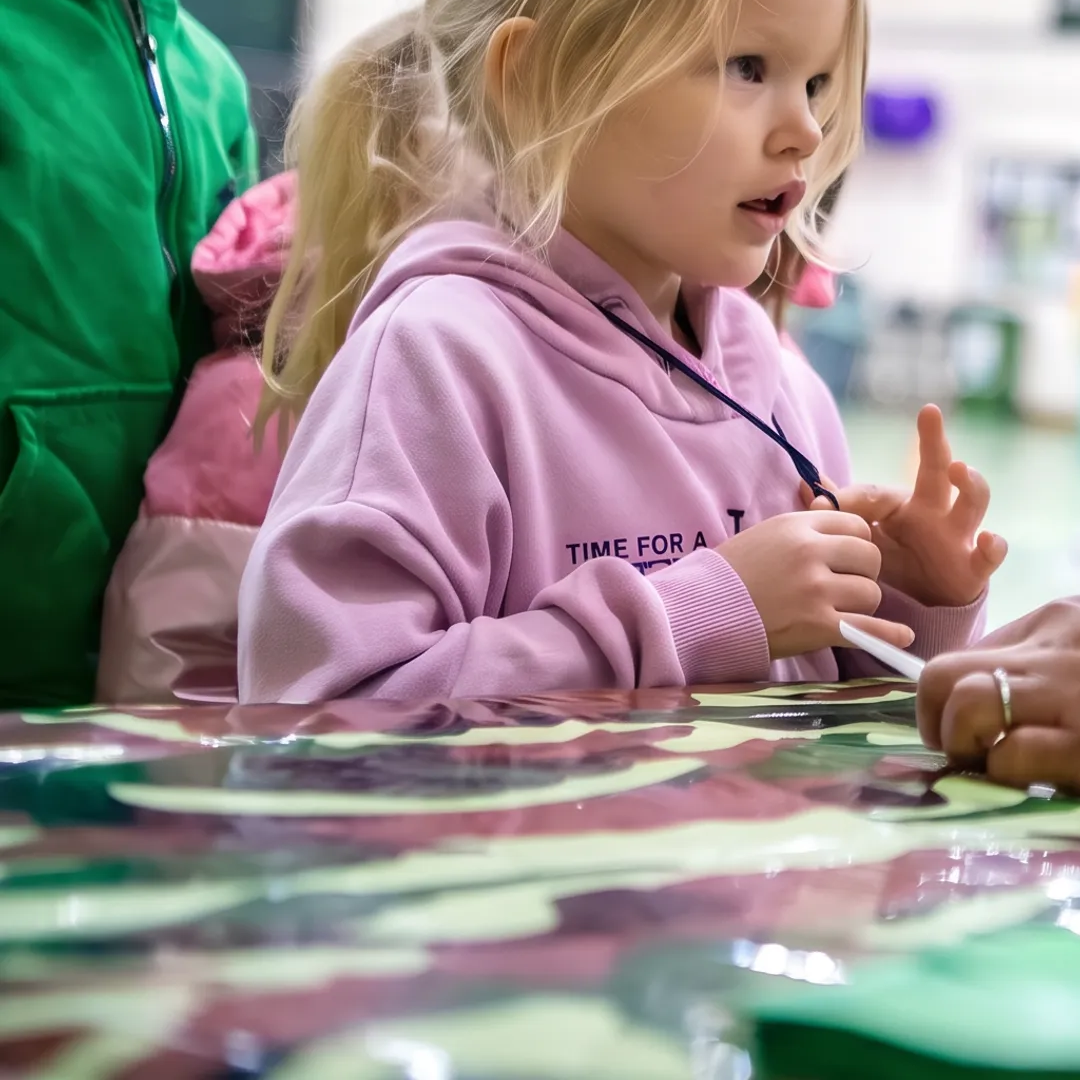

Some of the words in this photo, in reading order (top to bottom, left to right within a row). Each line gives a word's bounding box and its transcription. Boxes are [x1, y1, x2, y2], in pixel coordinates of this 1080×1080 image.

[565, 538, 629, 565] TIME
[637, 533, 684, 557] FOR
[692, 531, 708, 552] A
